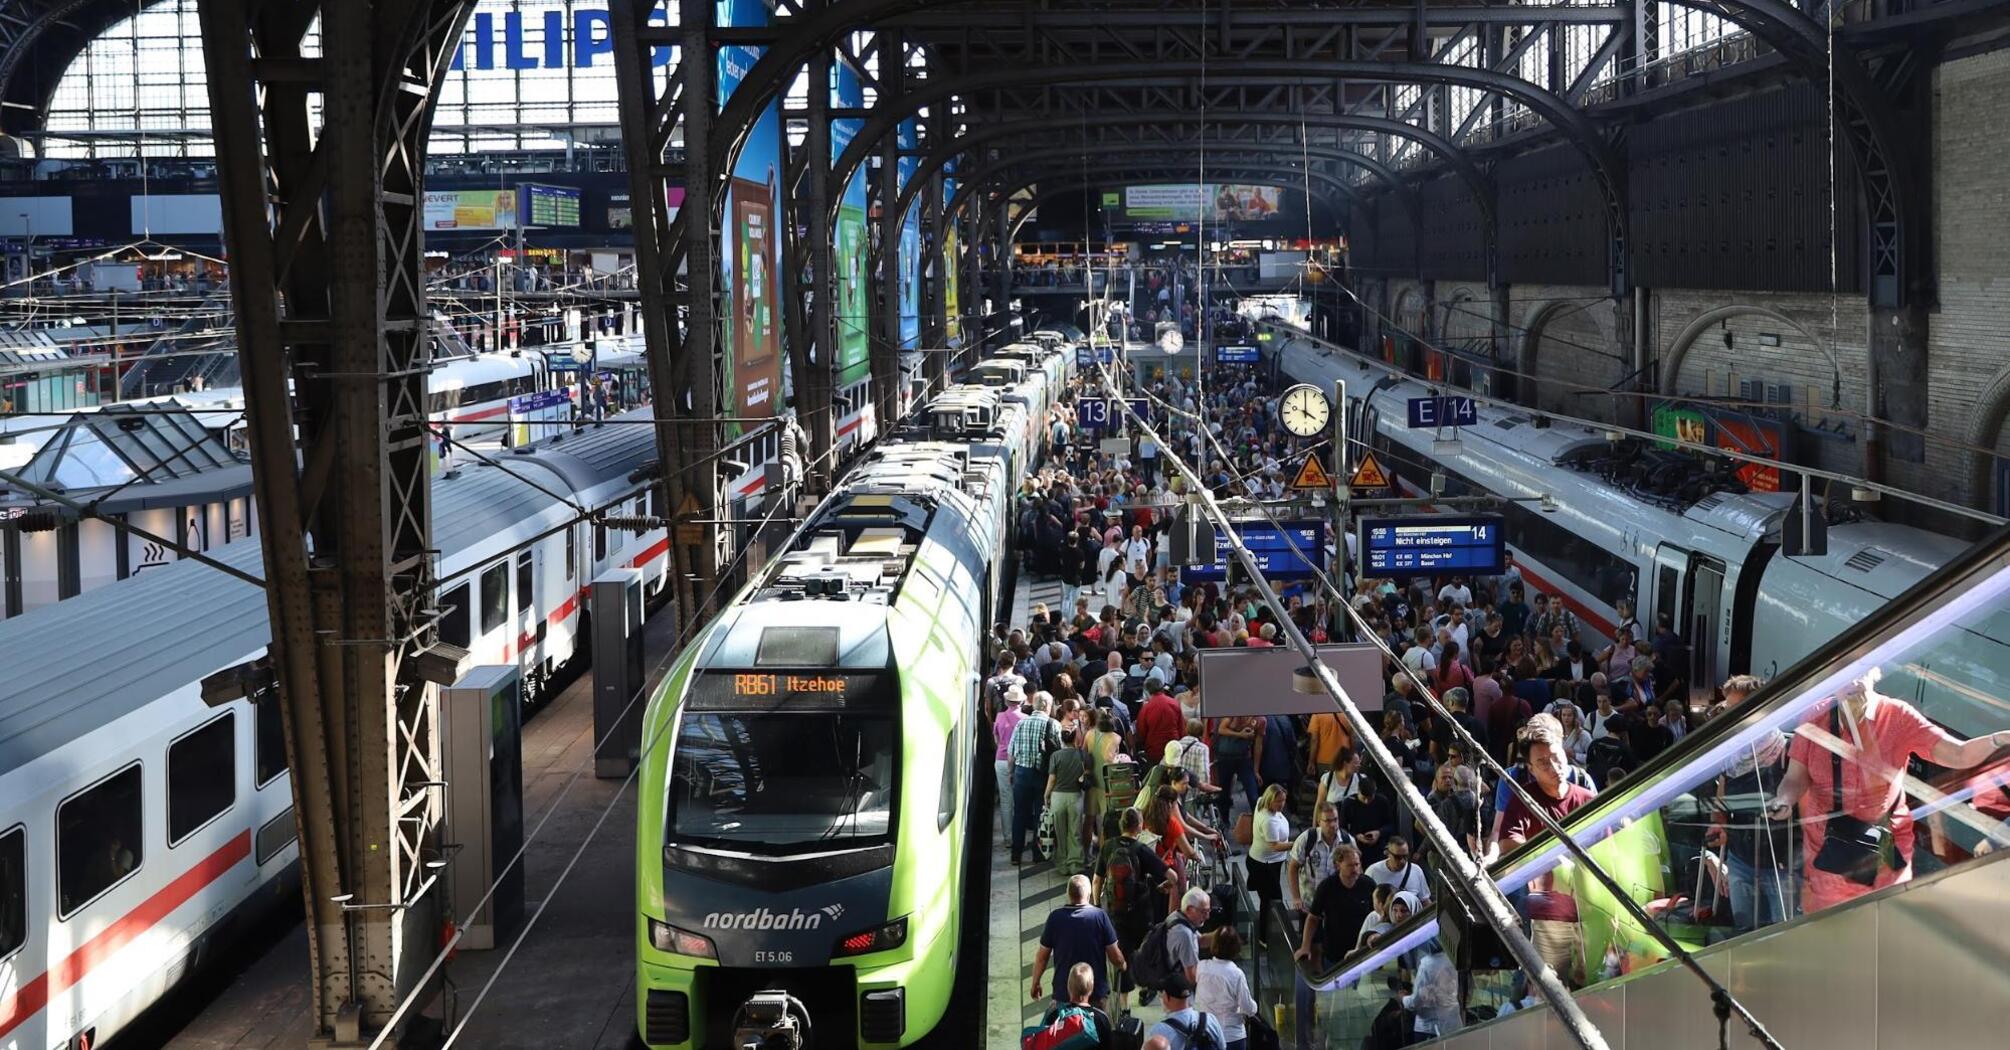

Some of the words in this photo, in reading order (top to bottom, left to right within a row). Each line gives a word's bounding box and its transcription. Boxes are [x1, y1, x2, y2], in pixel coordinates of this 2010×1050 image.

[1083, 401, 1107, 422] 13
[1419, 401, 1434, 423] E
[1449, 399, 1473, 419] 14
[1396, 537, 1414, 545] Nicht
[1416, 537, 1452, 546] einsteigen
[1472, 526, 1486, 540] 14
[735, 674, 776, 695] RB61
[787, 676, 846, 692] Itzehoe
[704, 908, 821, 930] nordbahn
[755, 951, 765, 962] ET
[768, 951, 793, 963] 5.06
